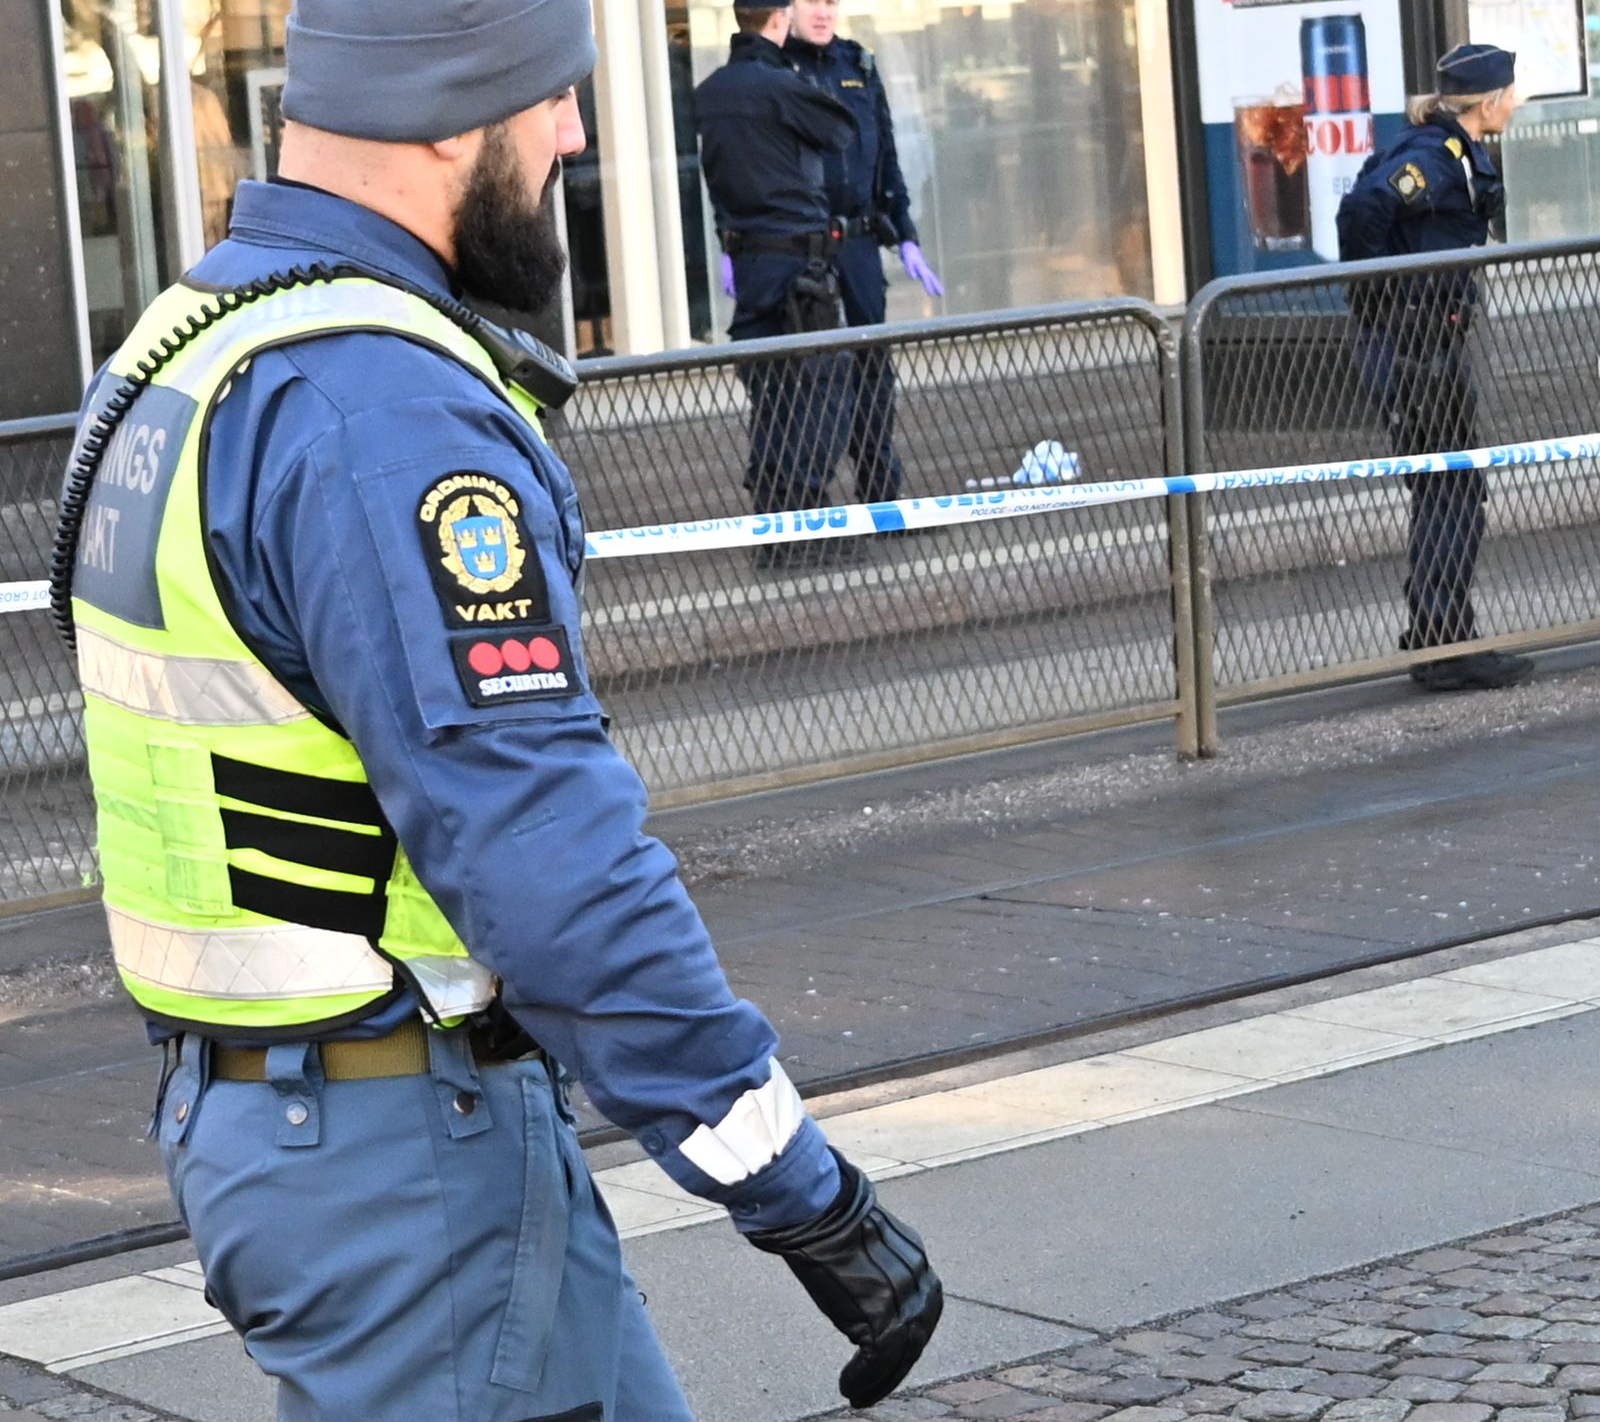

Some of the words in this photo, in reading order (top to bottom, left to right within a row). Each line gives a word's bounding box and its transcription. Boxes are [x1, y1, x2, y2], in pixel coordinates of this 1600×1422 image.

[420, 474, 520, 523] ORDNINGS
[455, 598, 533, 622] VAKT
[478, 671, 569, 697] SECURITAS
